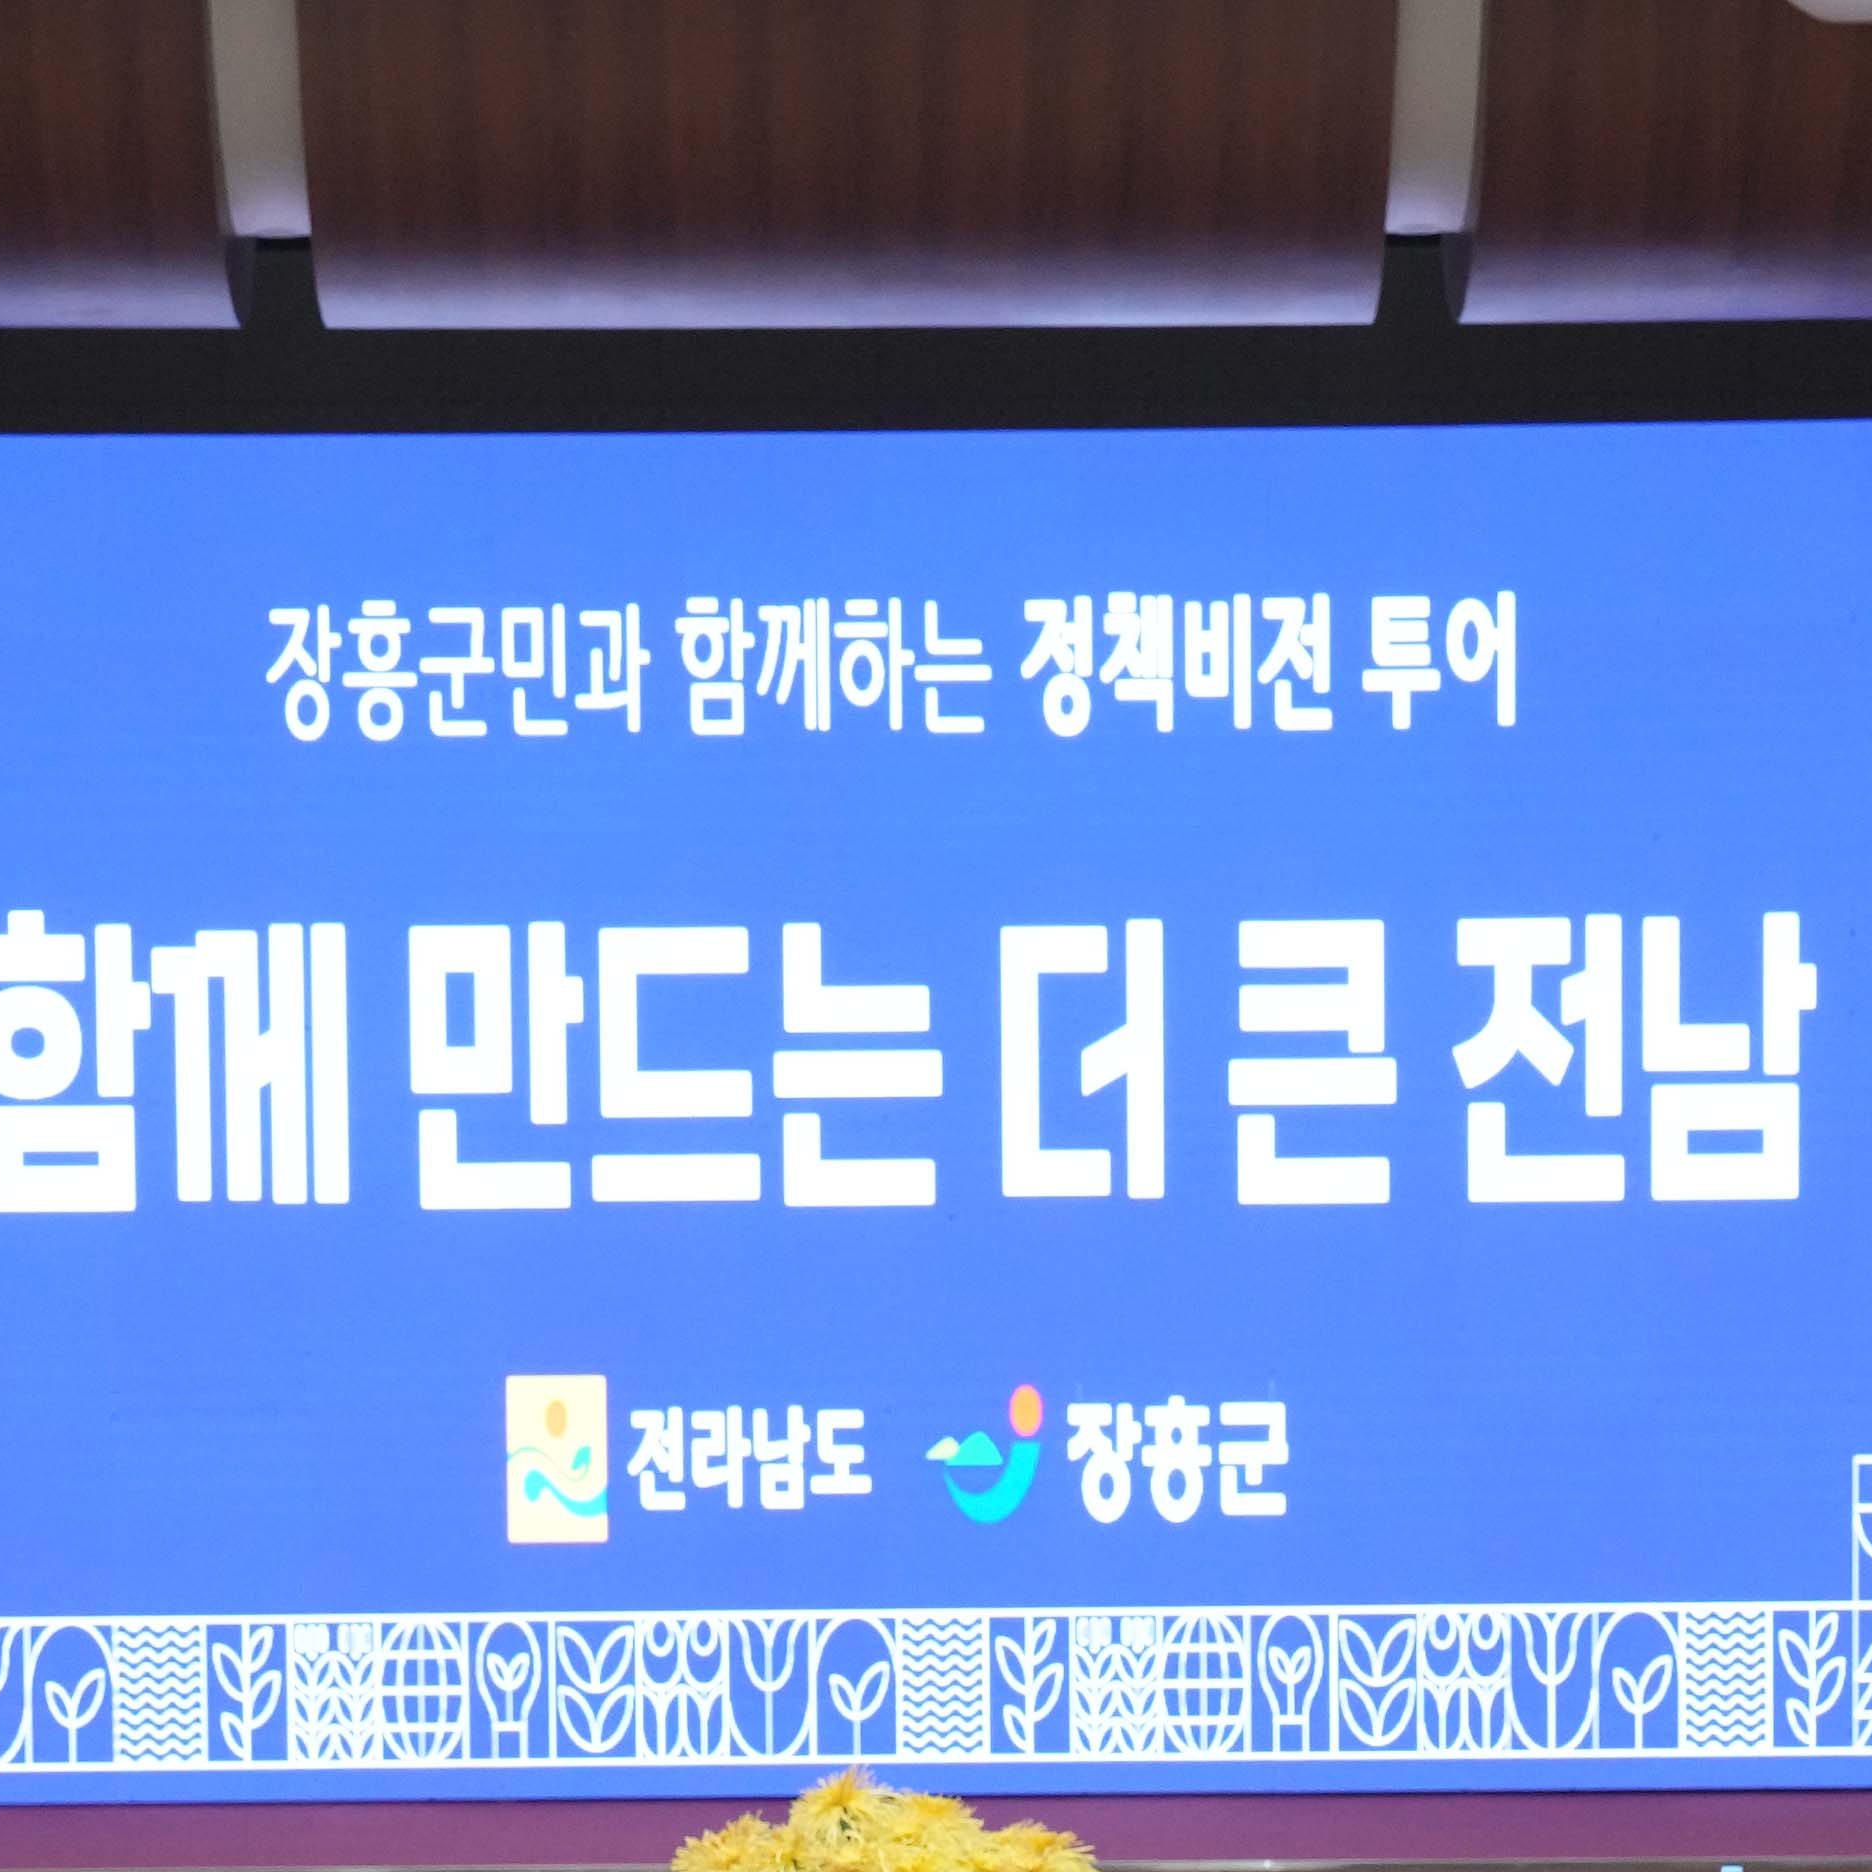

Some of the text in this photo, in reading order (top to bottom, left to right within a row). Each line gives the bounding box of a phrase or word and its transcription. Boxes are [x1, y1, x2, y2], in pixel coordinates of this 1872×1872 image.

[266, 590, 1517, 742] 장흥군민과 함께하는 정책비전 투어
[408, 921, 944, 1211] 만드는
[999, 918, 1165, 1200] 더
[1227, 919, 1398, 1206] 큰
[1452, 911, 1818, 1204] 전남
[626, 1404, 873, 1512] 전라남도
[1066, 1394, 1290, 1524] 장흥군
